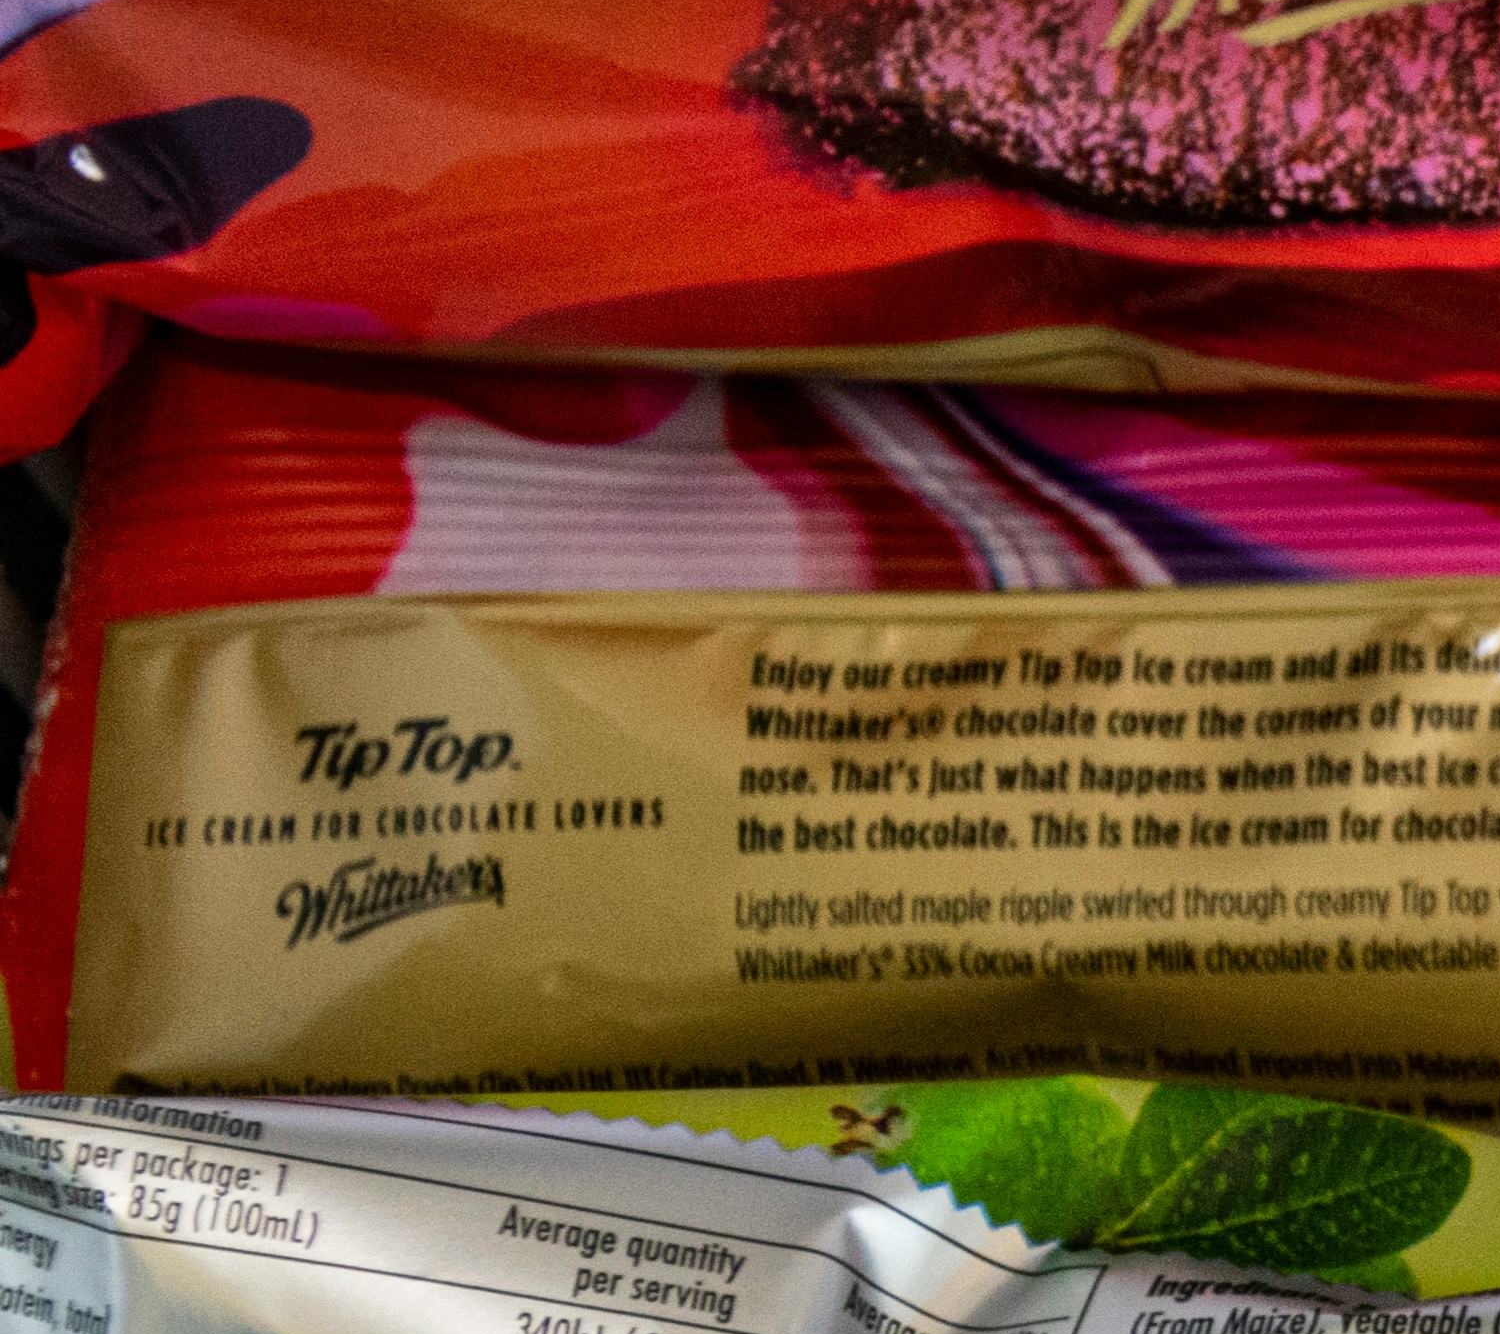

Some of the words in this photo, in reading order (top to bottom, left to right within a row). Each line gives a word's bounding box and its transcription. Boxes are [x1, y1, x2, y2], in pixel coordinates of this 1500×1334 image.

[953, 704, 1096, 739] chocolate
[1106, 708, 1185, 739] cover
[1198, 703, 1246, 738] the
[1255, 700, 1360, 738] corners
[1370, 695, 1401, 729] of
[1411, 700, 1478, 736] your
[738, 764, 817, 794] nose.
[830, 759, 920, 794] That's
[927, 759, 984, 798] just
[996, 759, 1070, 792] what
[1079, 759, 1208, 797] happens
[1218, 759, 1295, 792] when
[1305, 754, 1352, 787] the
[1362, 754, 1427, 787] best
[1437, 753, 1479, 786] ice
[145, 818, 187, 848] ICE
[204, 813, 297, 847] CREAM
[312, 810, 361, 841] FOR
[377, 801, 538, 839] CHOCOLATE
[554, 797, 665, 831] LOVERS
[737, 817, 784, 853] the
[794, 816, 855, 850] best
[865, 815, 1020, 851] chocolate.
[1030, 811, 1089, 848] This
[1098, 812, 1122, 847] is
[1131, 813, 1182, 847] the
[1190, 814, 1232, 847] ice
[1240, 815, 1328, 846] cream
[1339, 808, 1384, 842] for
[276, 854, 505, 949] Whittaker's
[74, 1132, 124, 1171] per
[132, 1147, 260, 1194] package:
[274, 1164, 288, 1195] 1
[127, 1183, 183, 1233] 85g
[193, 1193, 320, 1251] (100mL)
[498, 1205, 617, 1255] Average
[626, 1235, 747, 1282] quantity
[572, 1266, 624, 1299] per
[632, 1276, 737, 1324] serving
